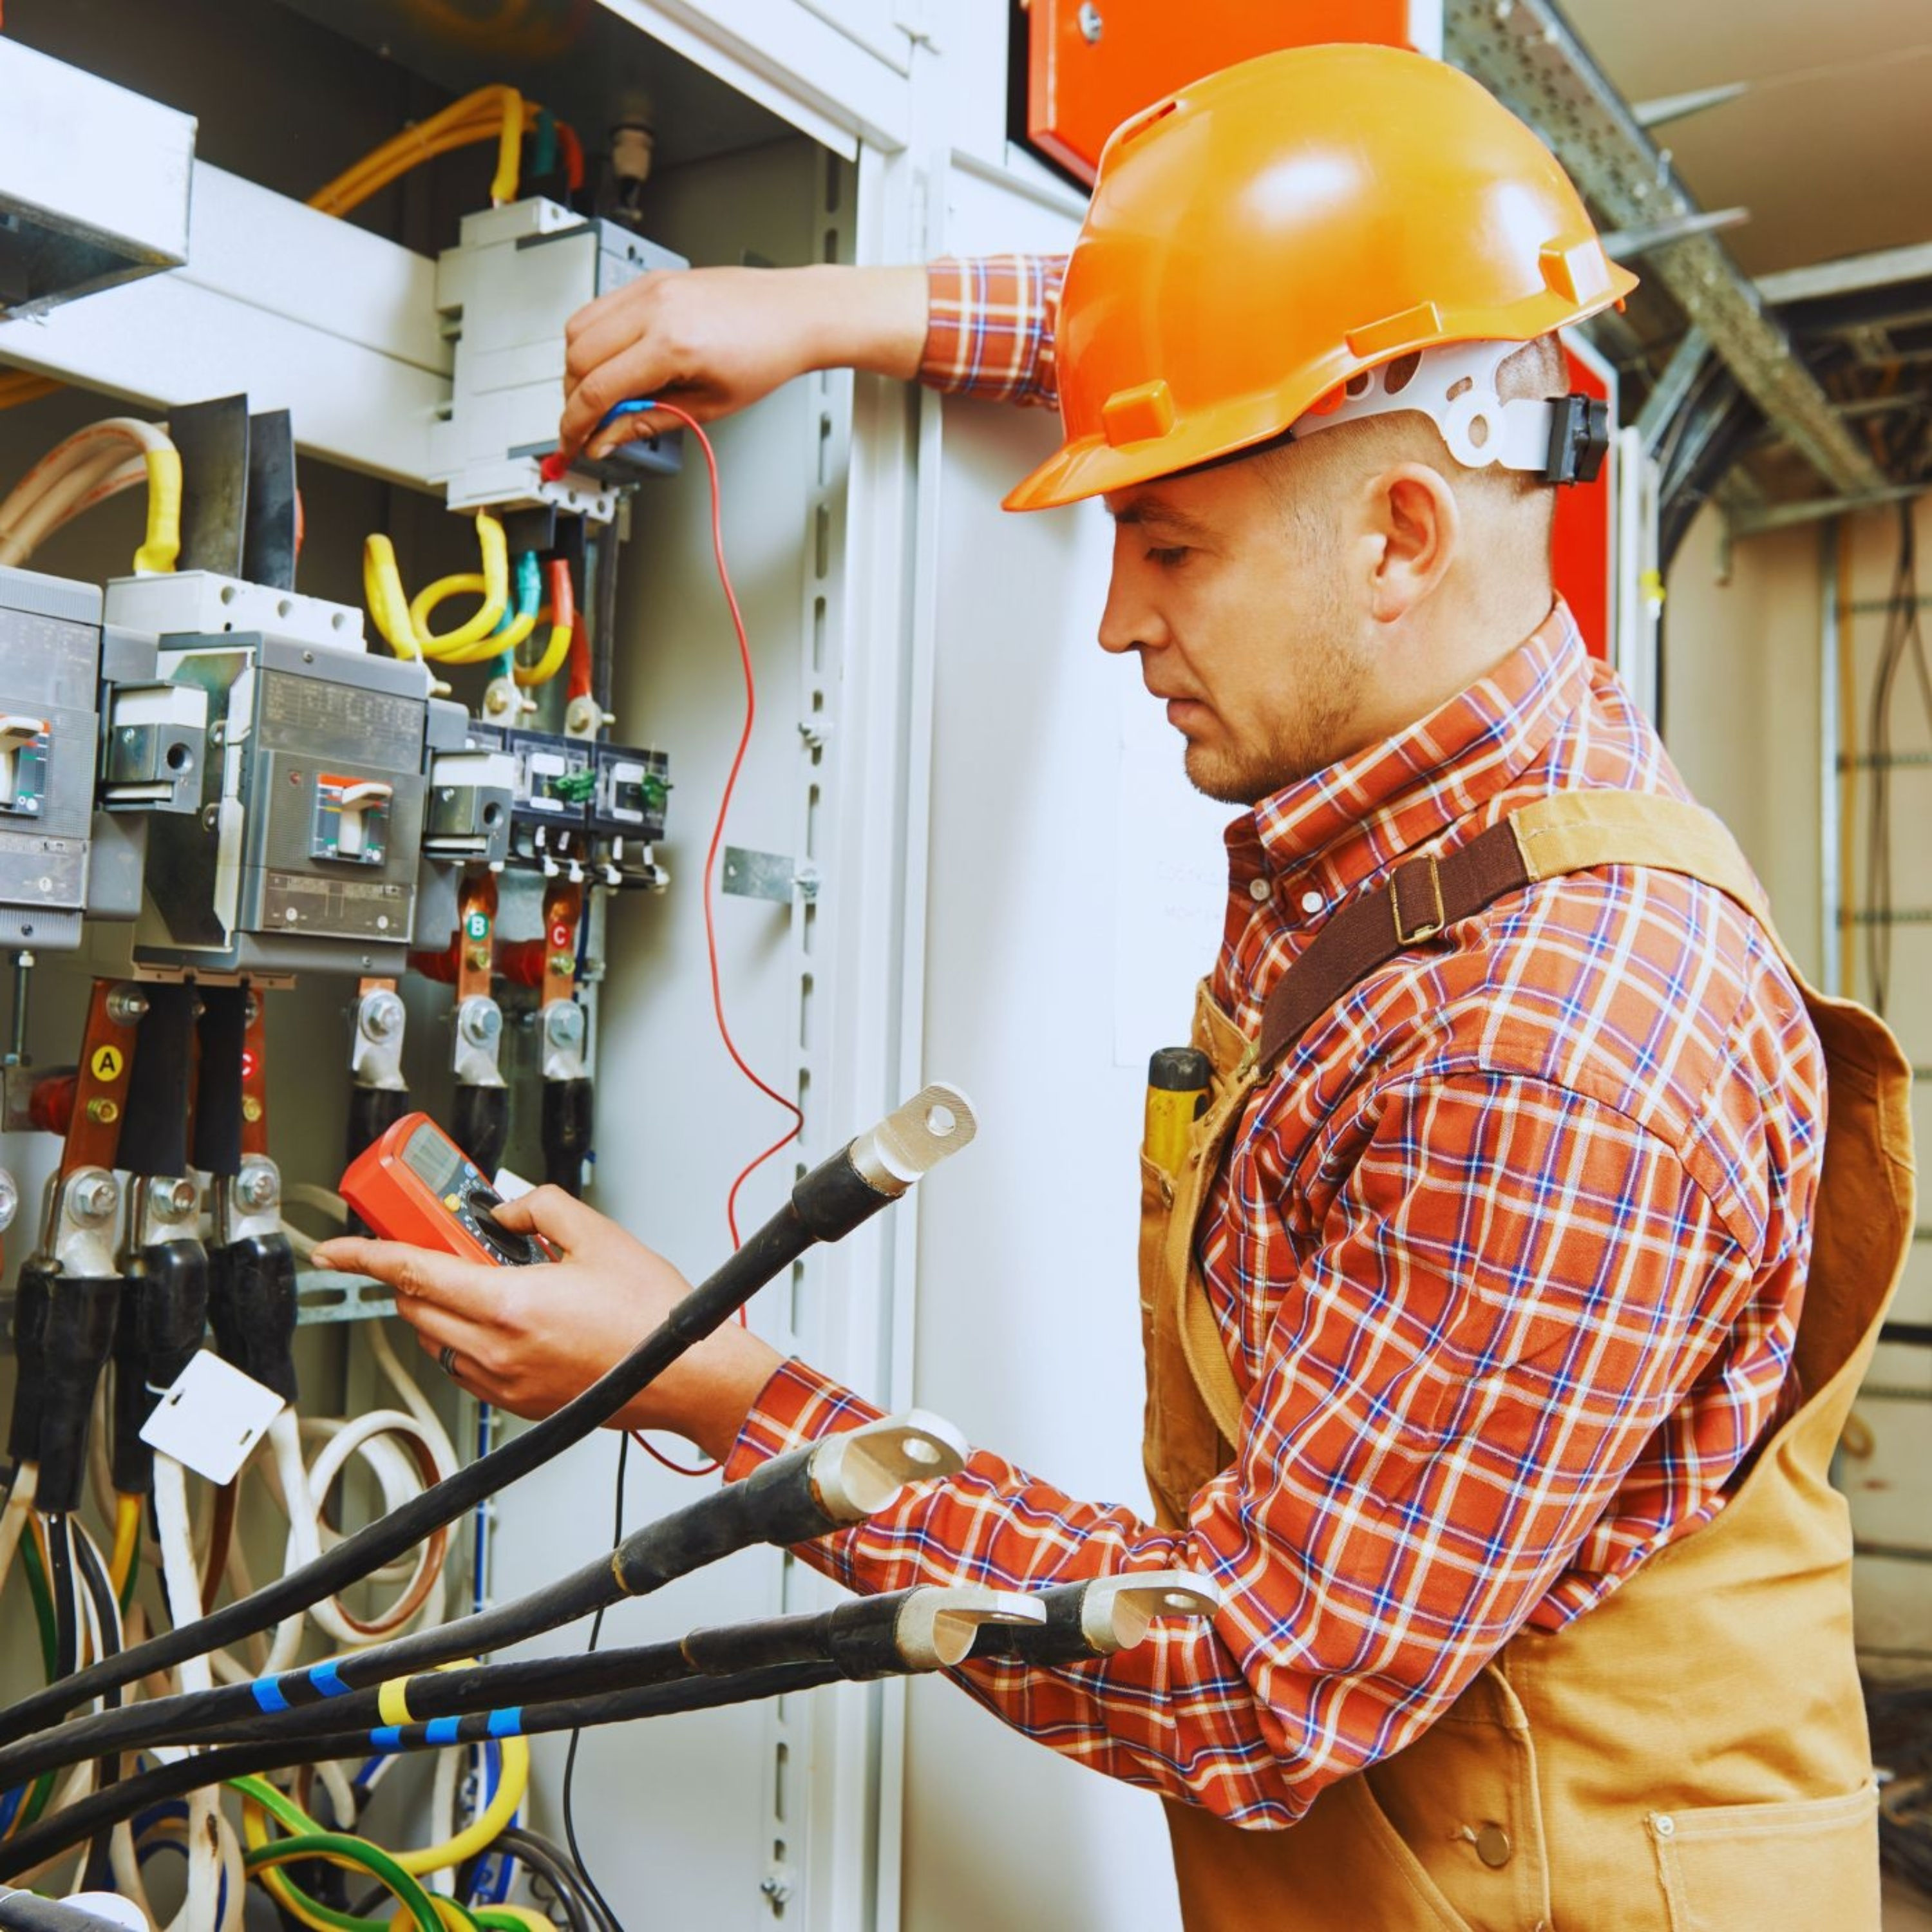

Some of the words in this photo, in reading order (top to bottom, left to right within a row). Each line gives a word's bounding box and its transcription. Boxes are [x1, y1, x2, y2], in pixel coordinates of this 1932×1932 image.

[471, 916, 485, 936] B
[553, 925, 566, 945] C
[99, 1051, 116, 1073] A
